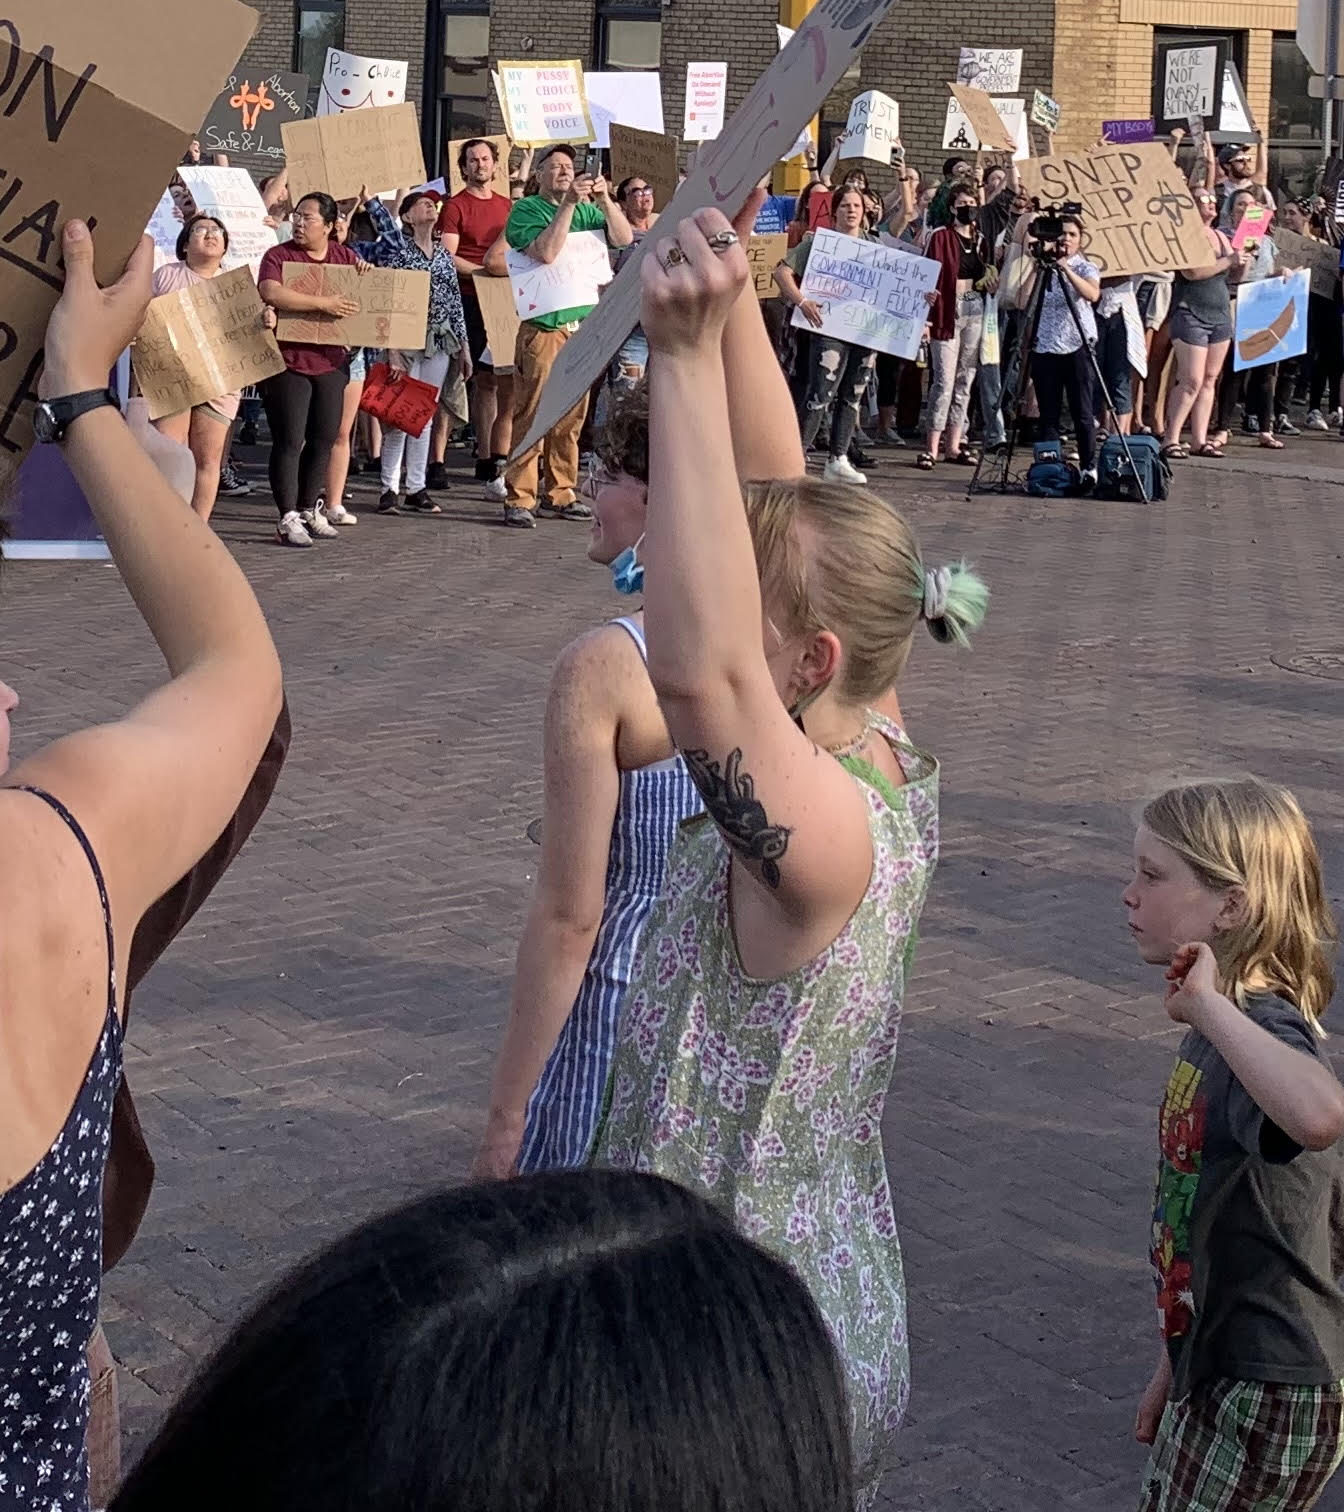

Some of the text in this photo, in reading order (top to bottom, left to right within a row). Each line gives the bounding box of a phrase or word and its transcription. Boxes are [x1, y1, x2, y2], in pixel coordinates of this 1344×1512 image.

[978, 51, 1016, 64] WE ARE
[508, 70, 570, 82] MY PUSSY
[988, 64, 1012, 76] NOT
[1168, 67, 1194, 84] NOT
[265, 73, 301, 115] Abortion
[535, 85, 578, 97] CHOICE
[513, 102, 573, 114] MY BODY
[854, 100, 895, 120] TRUST
[514, 118, 578, 130] MY VOICE
[844, 124, 893, 141] WOMEN
[1105, 122, 1121, 137] MY
[206, 125, 287, 158] Safe & Lega
[1040, 152, 1143, 200] SNIP
[1052, 186, 1134, 225] NIP
[1080, 221, 1188, 273] BITCH
[911, 260, 928, 284] the
[805, 274, 920, 317] UTERUS FUCK
